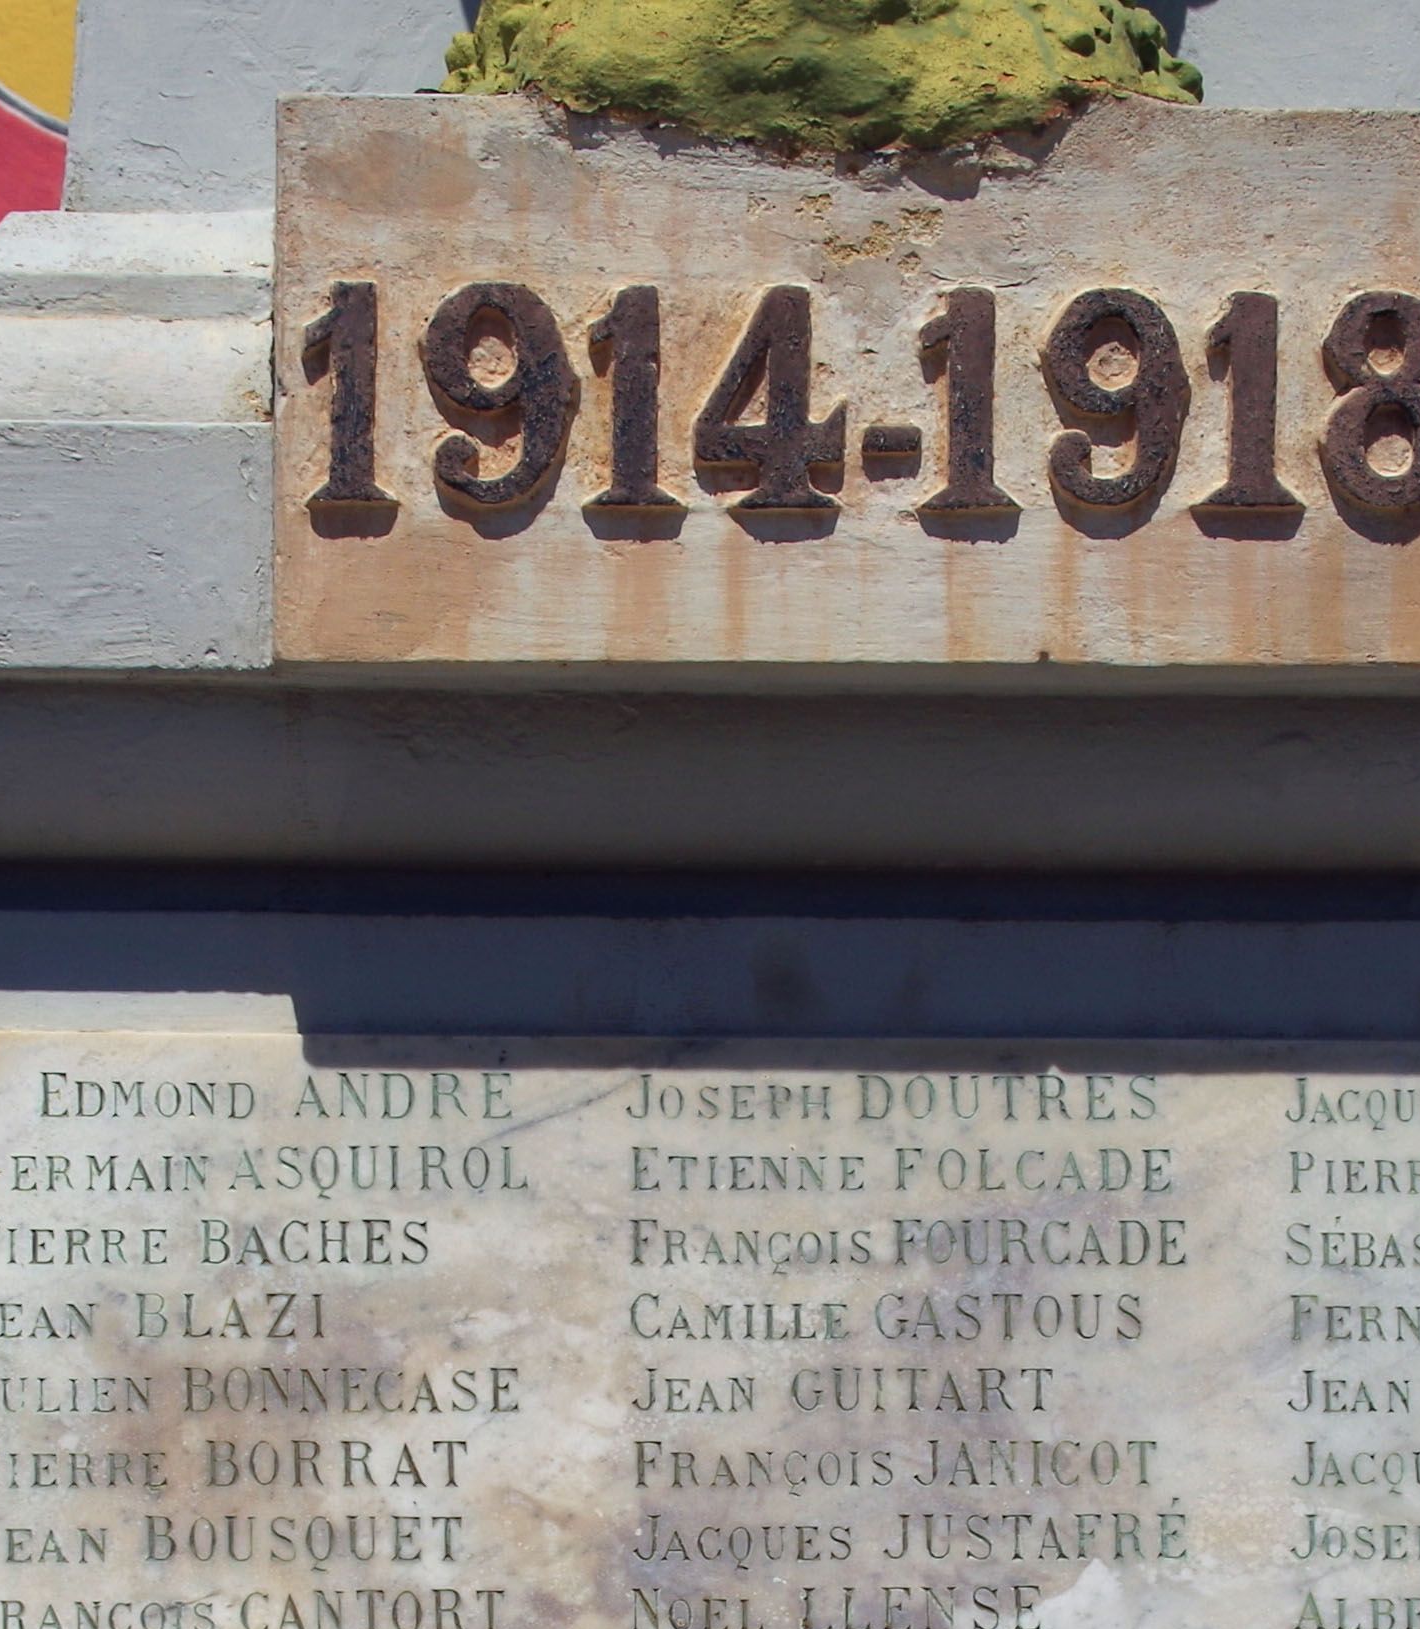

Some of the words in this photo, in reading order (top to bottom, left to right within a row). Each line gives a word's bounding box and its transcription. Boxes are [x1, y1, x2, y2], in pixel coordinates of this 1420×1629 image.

[40, 1072, 256, 1119] EDMOND
[295, 1072, 514, 1119] ANDRE
[626, 1074, 832, 1121] JOSEPH
[857, 1074, 1158, 1121] DOUTRES
[229, 1145, 529, 1199] ASQUIROL
[630, 1147, 866, 1192] ETIENNE
[894, 1148, 1174, 1193] FOLCADE
[200, 1218, 431, 1266] BACHES
[629, 1218, 874, 1274] FRANÇOIS
[892, 1218, 1188, 1267] FOURCADE
[137, 1292, 326, 1340] BLAZI
[628, 1293, 850, 1341] CAMILLE
[874, 1293, 1145, 1341] GASTOUS
[183, 1367, 521, 1414] BONNECASE
[631, 1368, 757, 1413] JEAN
[791, 1368, 1055, 1413] GUITART
[1287, 1370, 1413, 1413] JEAN
[205, 1439, 469, 1488] BORRAT
[633, 1440, 894, 1496] FRANÇOIS
[912, 1439, 1160, 1488] JANICOT
[144, 1515, 464, 1572] BOUSQUET
[632, 1515, 854, 1571] JACQUES
[882, 1498, 1188, 1561] JUSTAFRÉ
